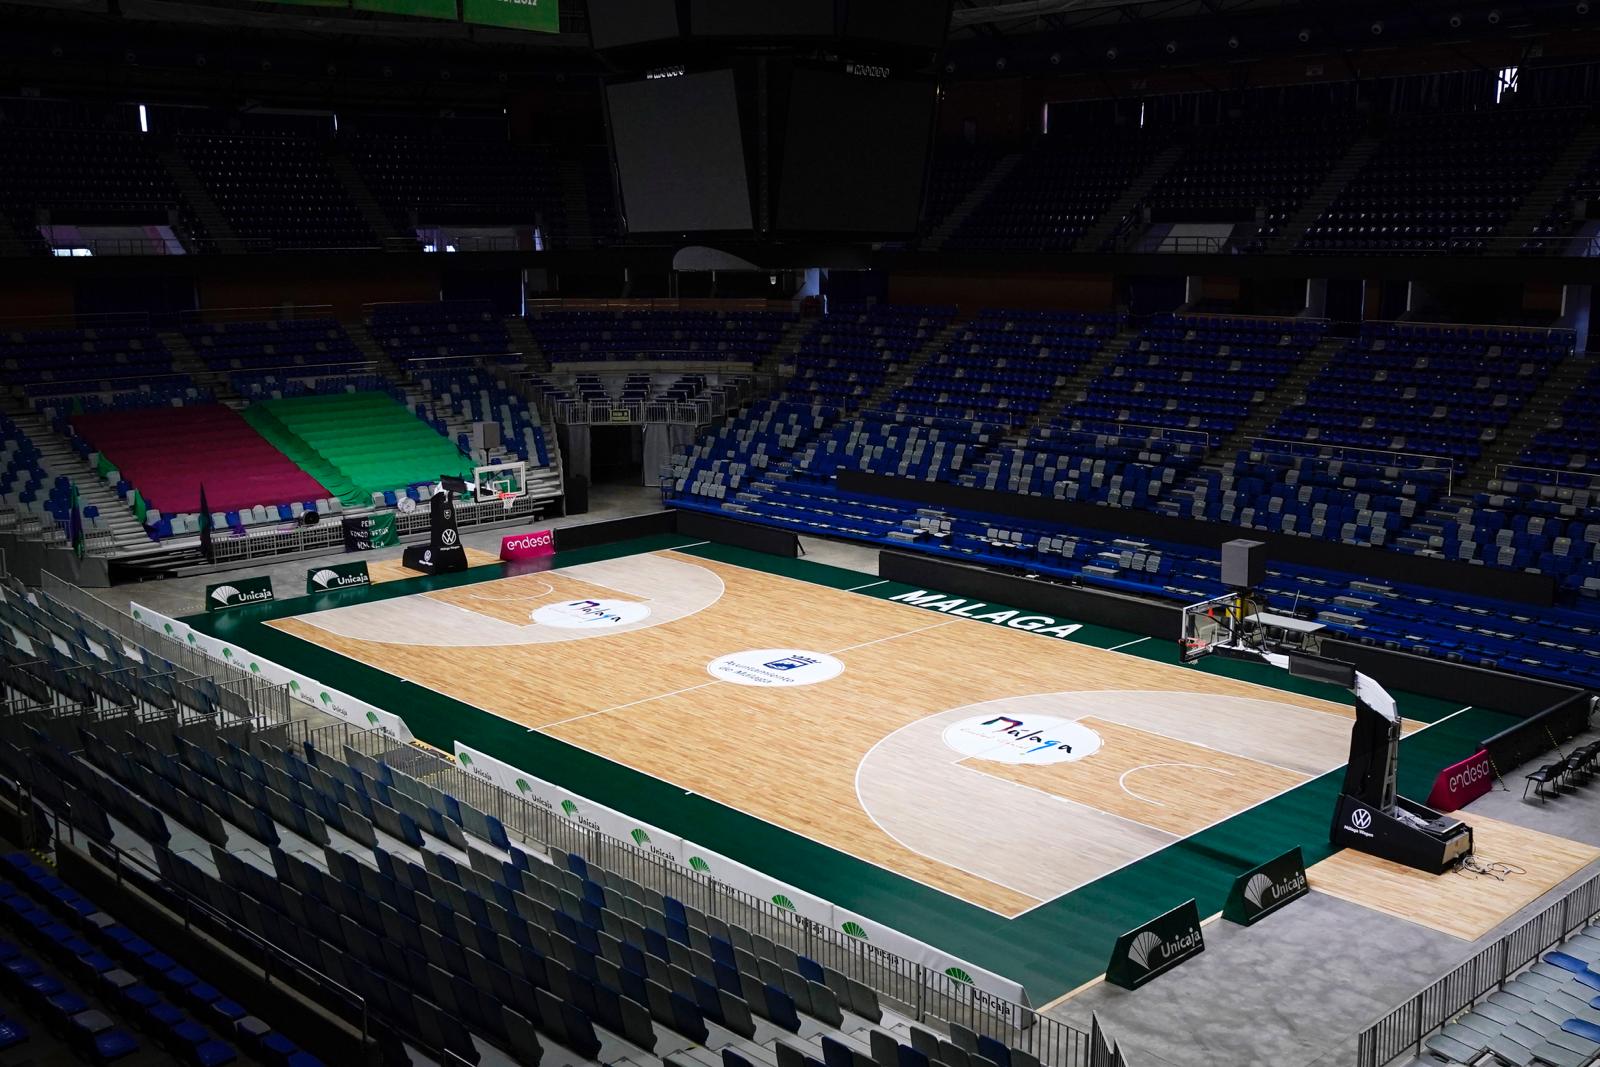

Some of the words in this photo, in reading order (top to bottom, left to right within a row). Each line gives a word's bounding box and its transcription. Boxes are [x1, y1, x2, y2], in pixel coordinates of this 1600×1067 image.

[507, 534, 550, 550] endesa
[337, 573, 368, 585] Unicaja
[238, 588, 272, 601] Unicaja
[888, 590, 1084, 638] MALAGA
[473, 766, 492, 781] Unicaja
[1449, 760, 1489, 793] endesa
[578, 815, 600, 831] Unicaja
[650, 845, 675, 861] Unicaja
[1271, 871, 1305, 899] Unicaja
[1161, 927, 1200, 958] Unicaja
[973, 989, 1011, 1016] Unicaja
